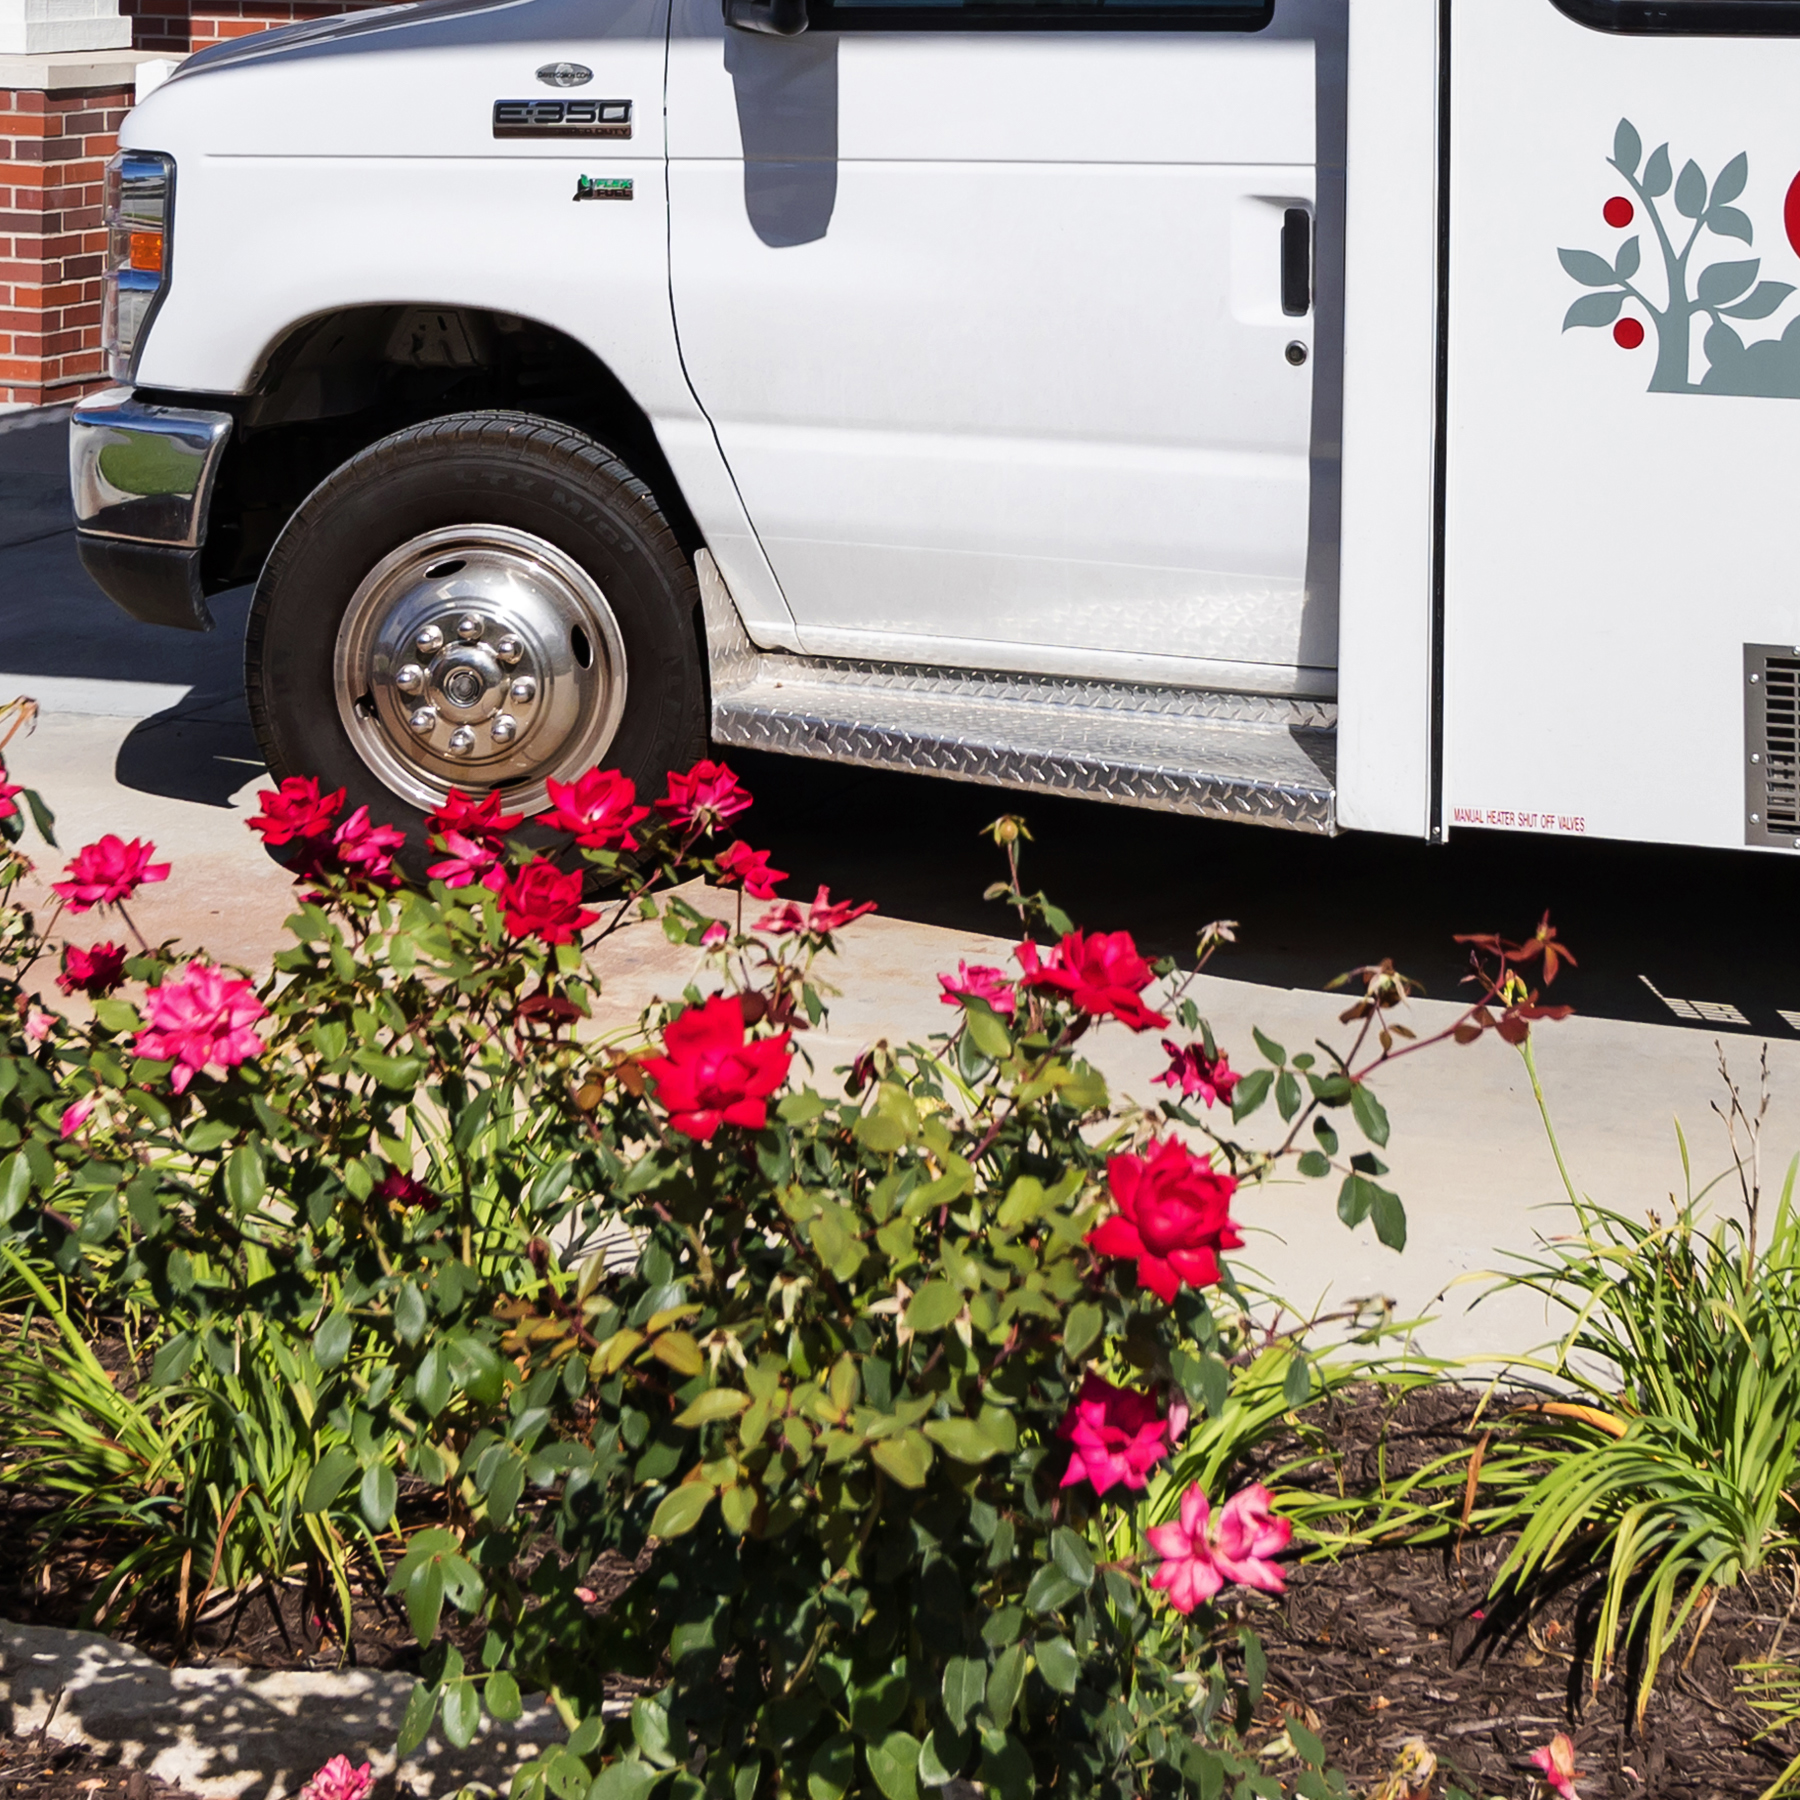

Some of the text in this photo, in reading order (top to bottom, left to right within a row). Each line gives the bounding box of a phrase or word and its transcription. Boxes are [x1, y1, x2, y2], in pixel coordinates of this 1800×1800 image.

[594, 127, 629, 137] DUTY
[596, 179, 632, 189] FLEX
[596, 189, 631, 198] FUEL
[1453, 807, 1586, 833] MANUAL HEATER SHUT OFF VALVES
